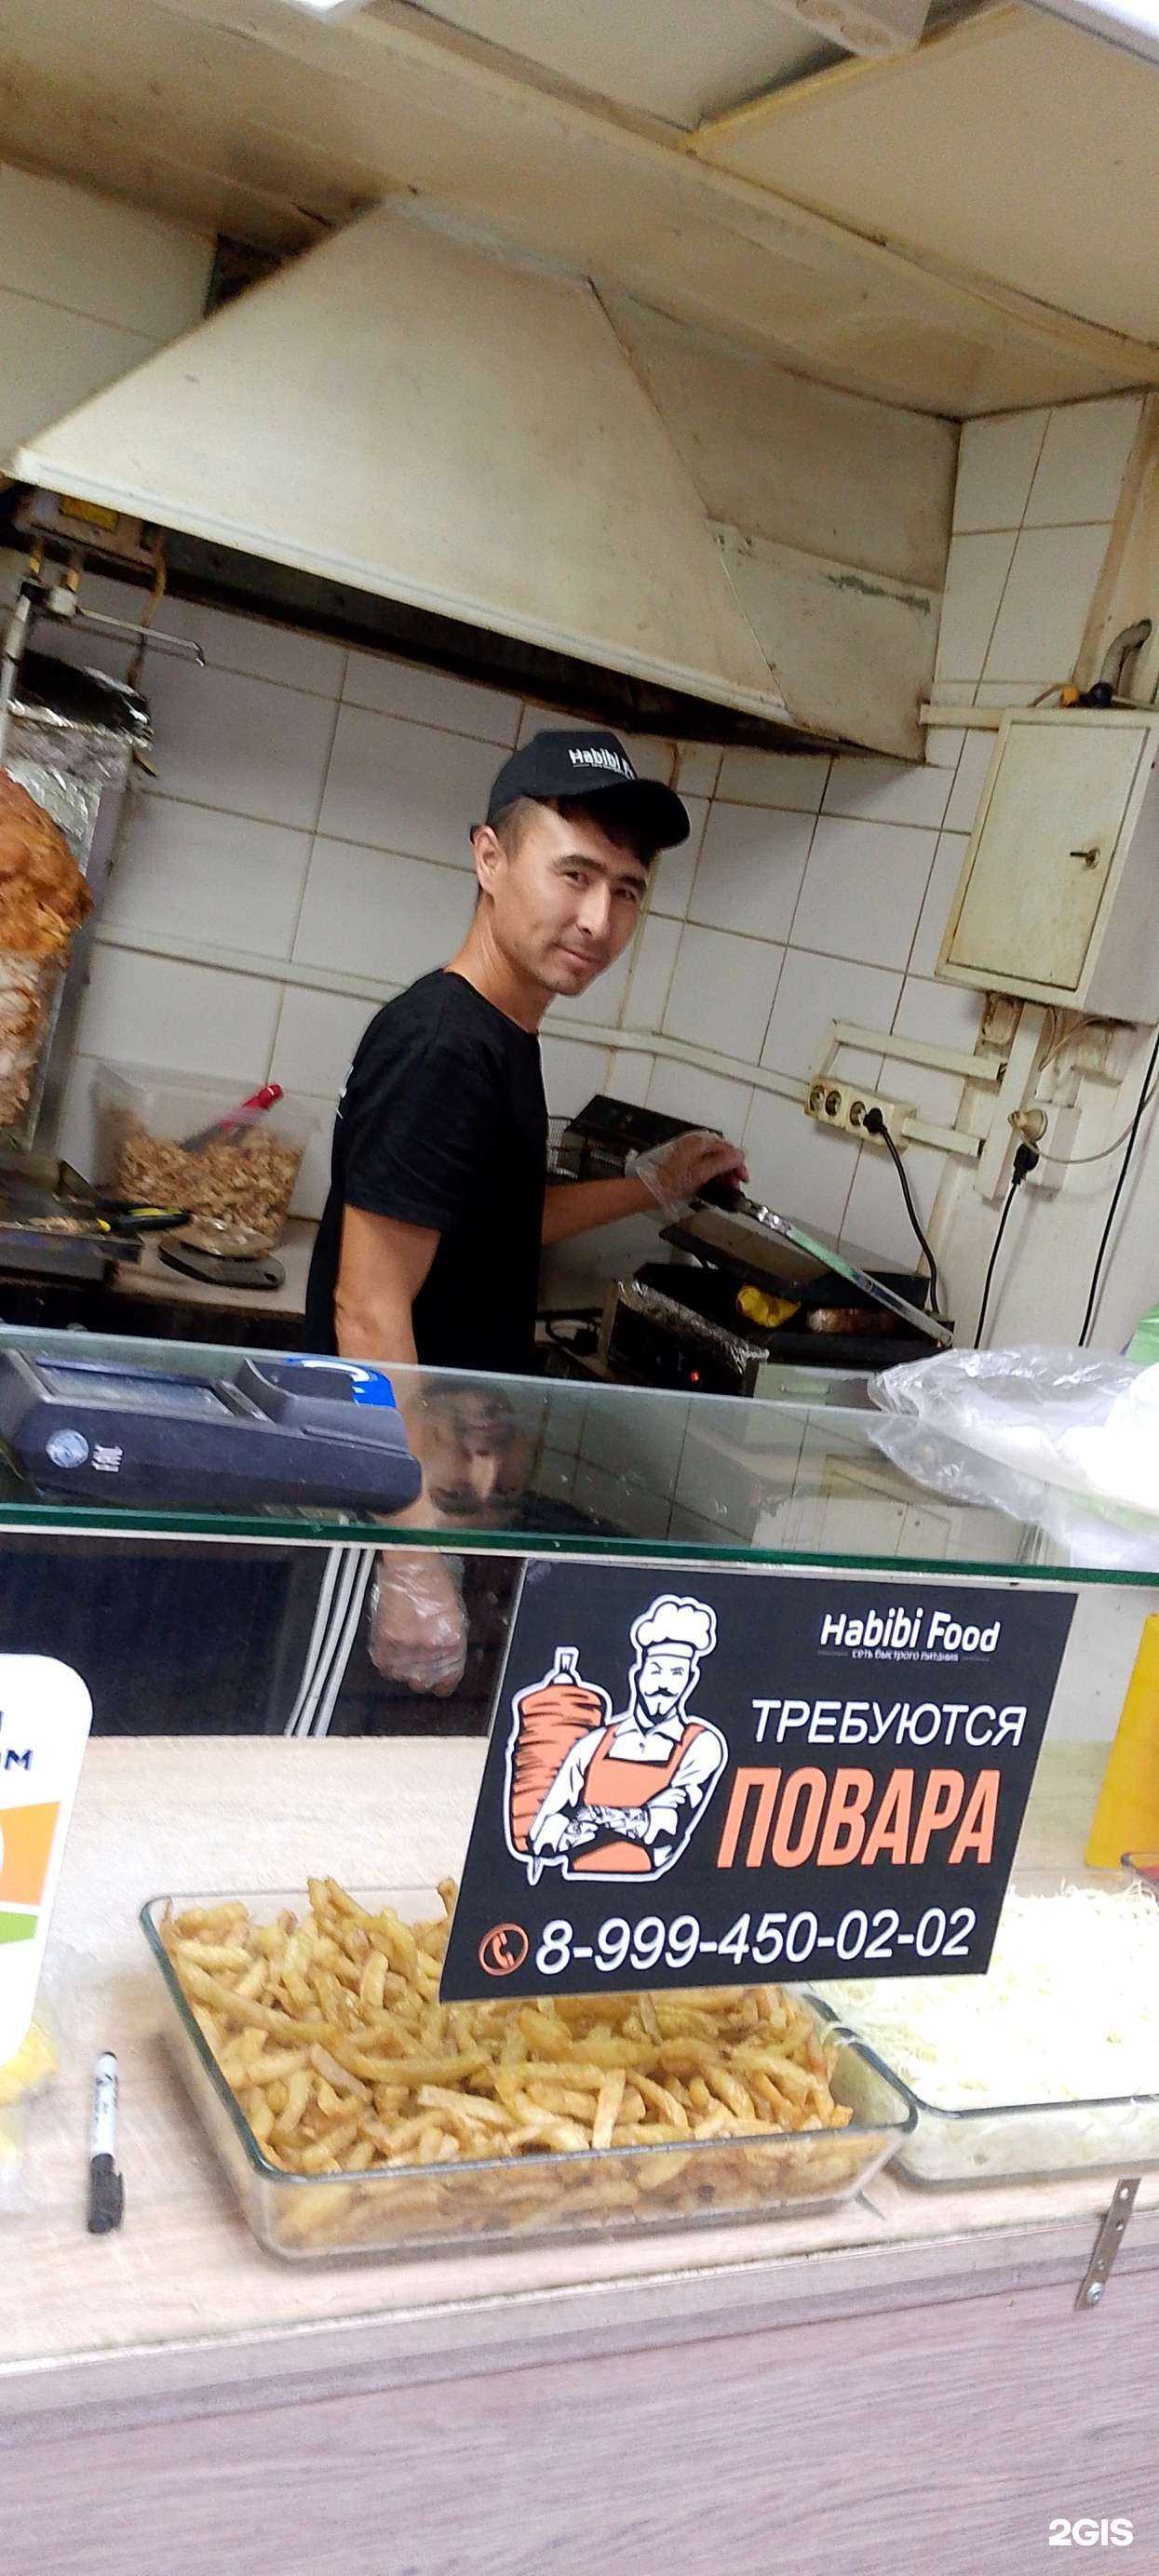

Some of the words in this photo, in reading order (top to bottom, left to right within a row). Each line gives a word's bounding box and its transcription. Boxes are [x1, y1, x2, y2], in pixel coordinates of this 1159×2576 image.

[568, 747, 622, 771] Habibi
[820, 1607, 923, 1648] Habibi
[926, 1611, 1001, 1652] Food
[751, 1698, 1027, 1747] ТРЕБУЮТСЯ
[718, 1768, 1001, 1869] ПОВАРА
[535, 1907, 977, 1975] 8-999-450-02-02
